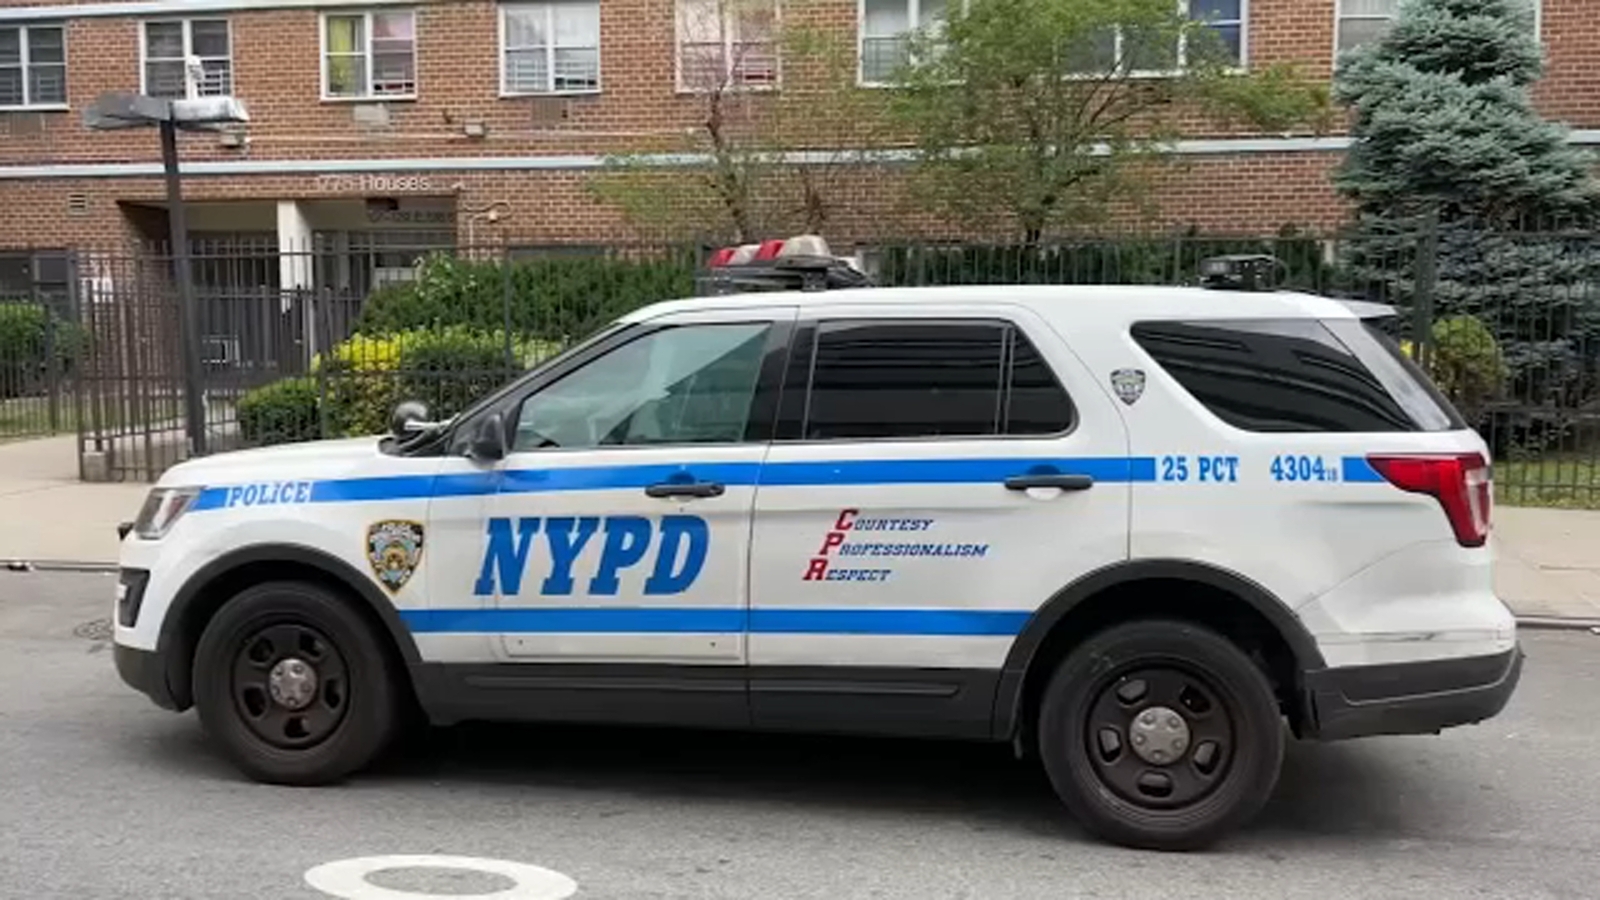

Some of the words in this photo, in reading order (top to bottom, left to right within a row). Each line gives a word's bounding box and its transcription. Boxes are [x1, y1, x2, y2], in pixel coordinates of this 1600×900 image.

[360, 174, 430, 191] Houses
[1162, 456, 1188, 481] 25
[1198, 456, 1239, 481] PCT
[1270, 456, 1326, 481] 4304
[229, 481, 310, 508] POLICE
[474, 514, 710, 595] NYPD
